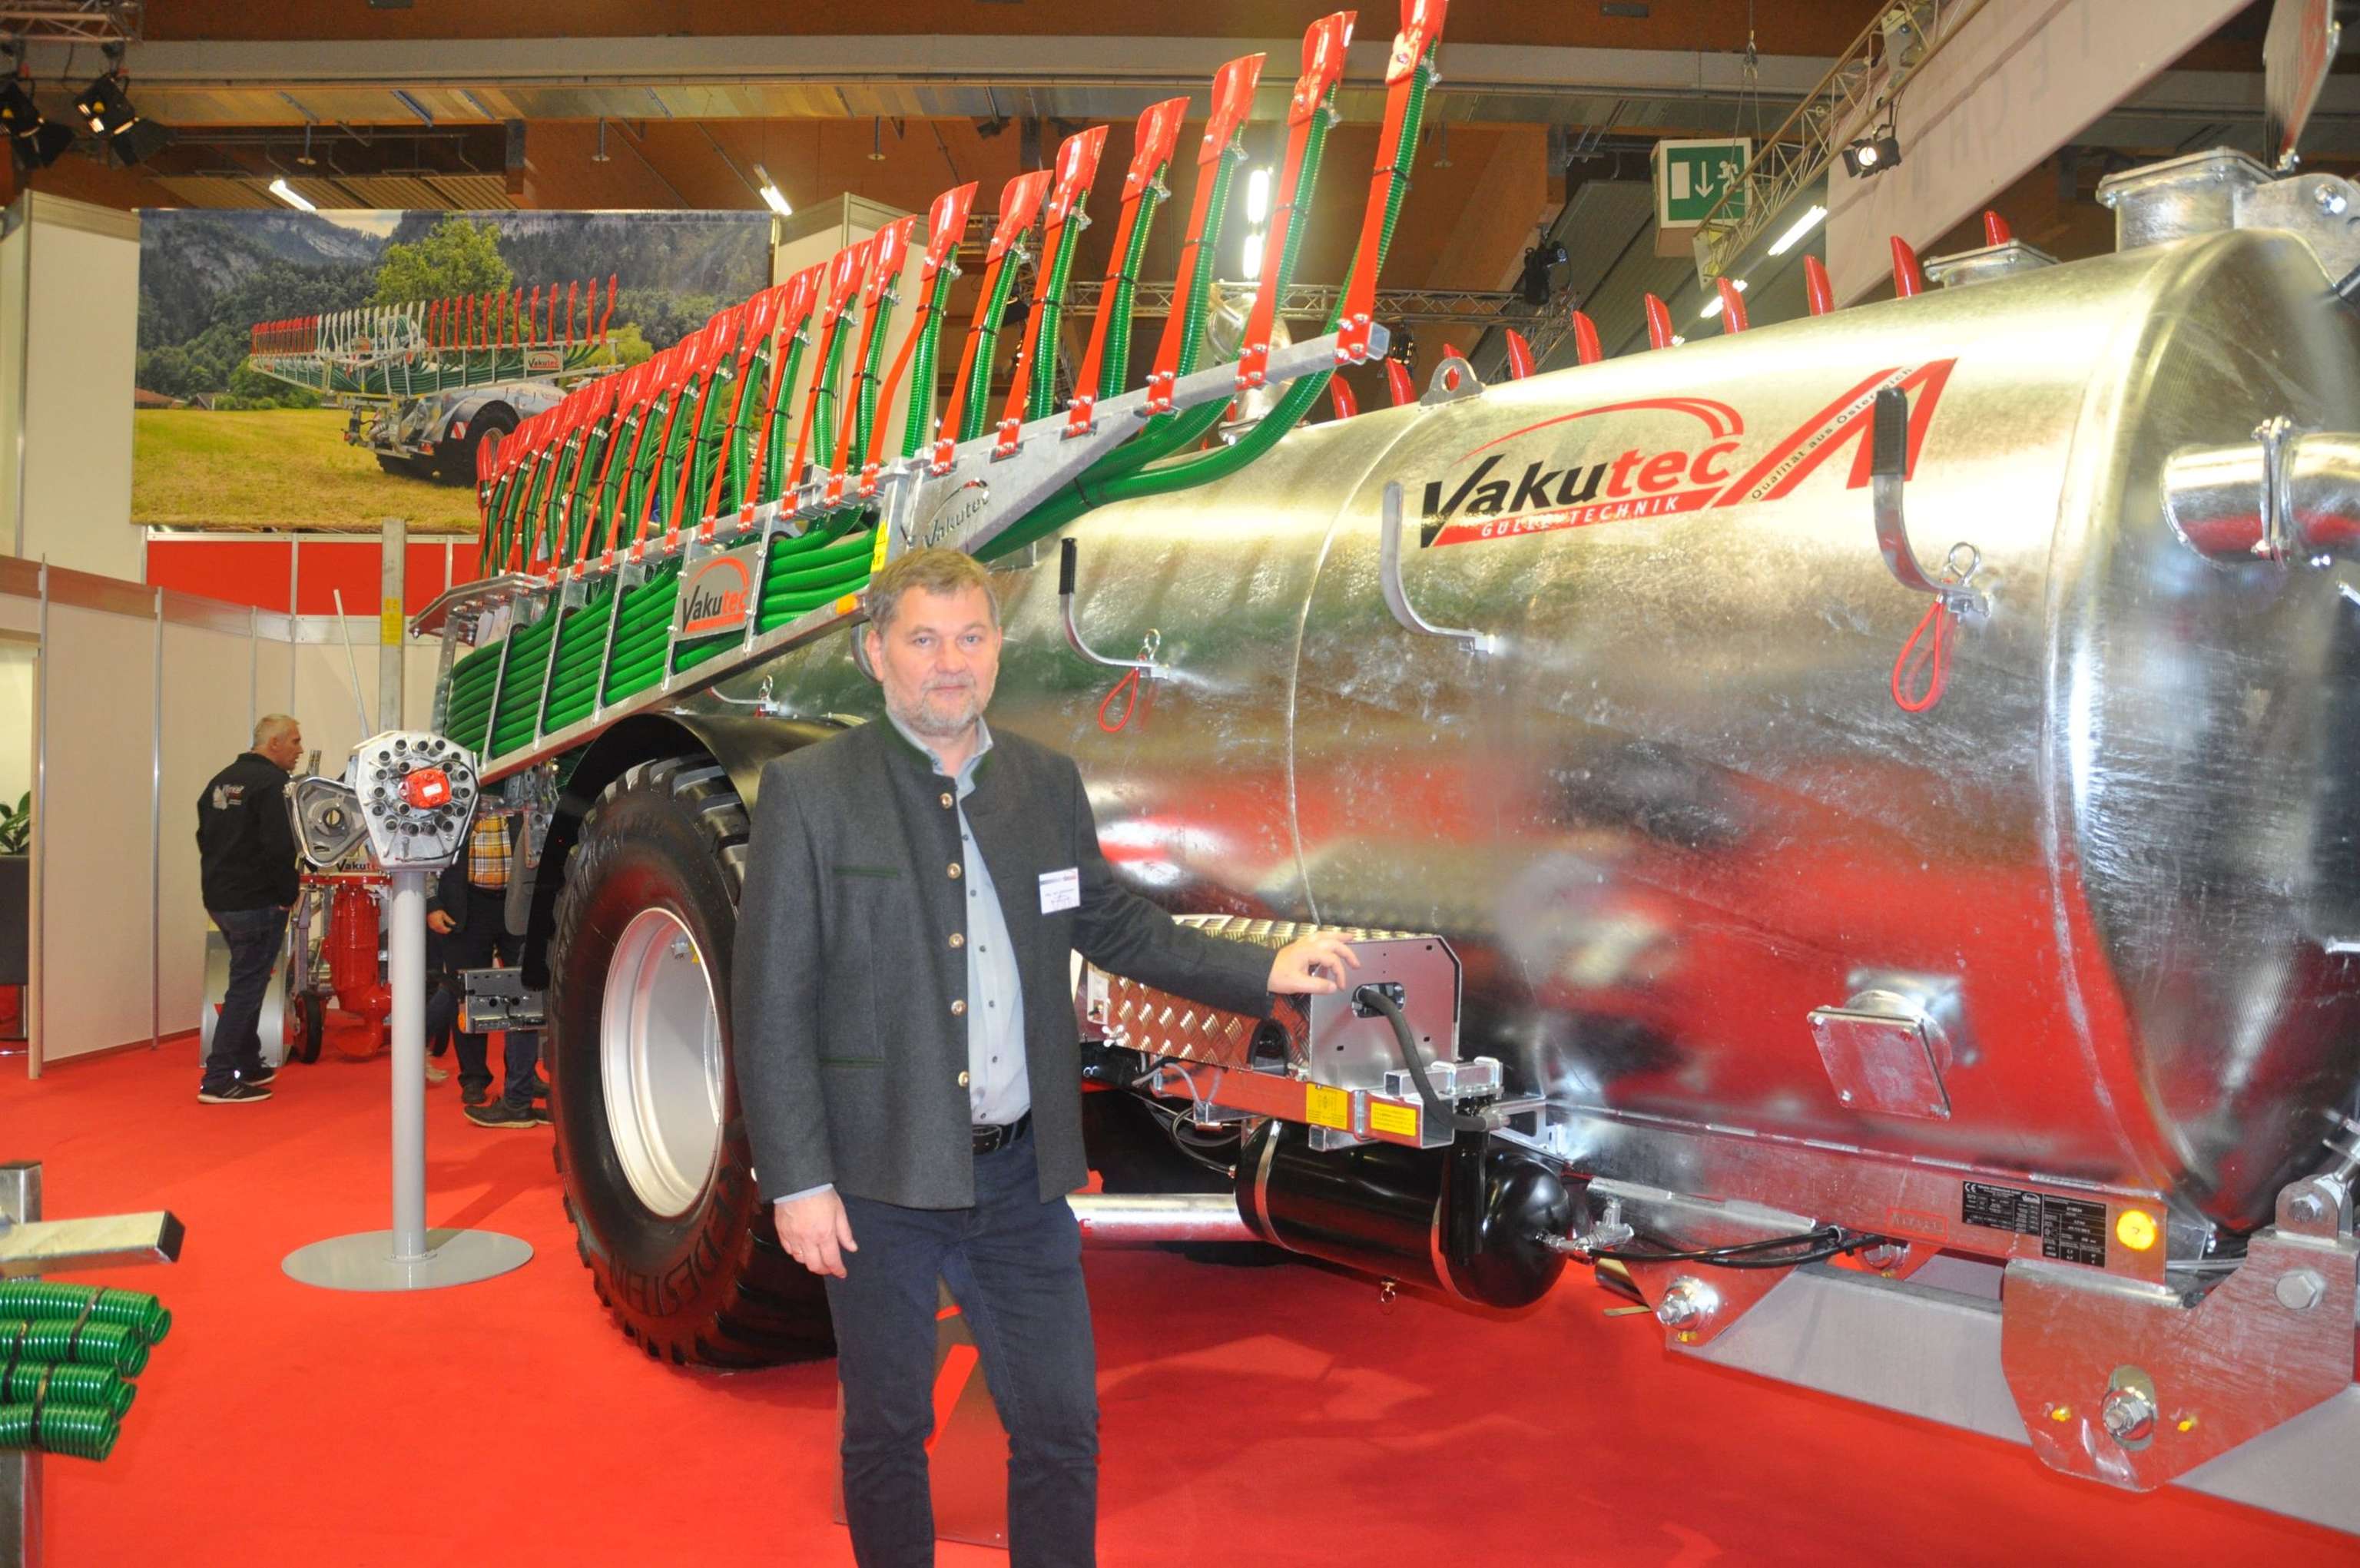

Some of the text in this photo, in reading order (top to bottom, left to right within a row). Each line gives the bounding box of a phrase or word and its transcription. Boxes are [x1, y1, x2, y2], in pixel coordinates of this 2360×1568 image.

[1809, 428, 1833, 449] aus
[1420, 442, 1740, 548] Vakutec
[683, 585, 749, 632] Vakutec
